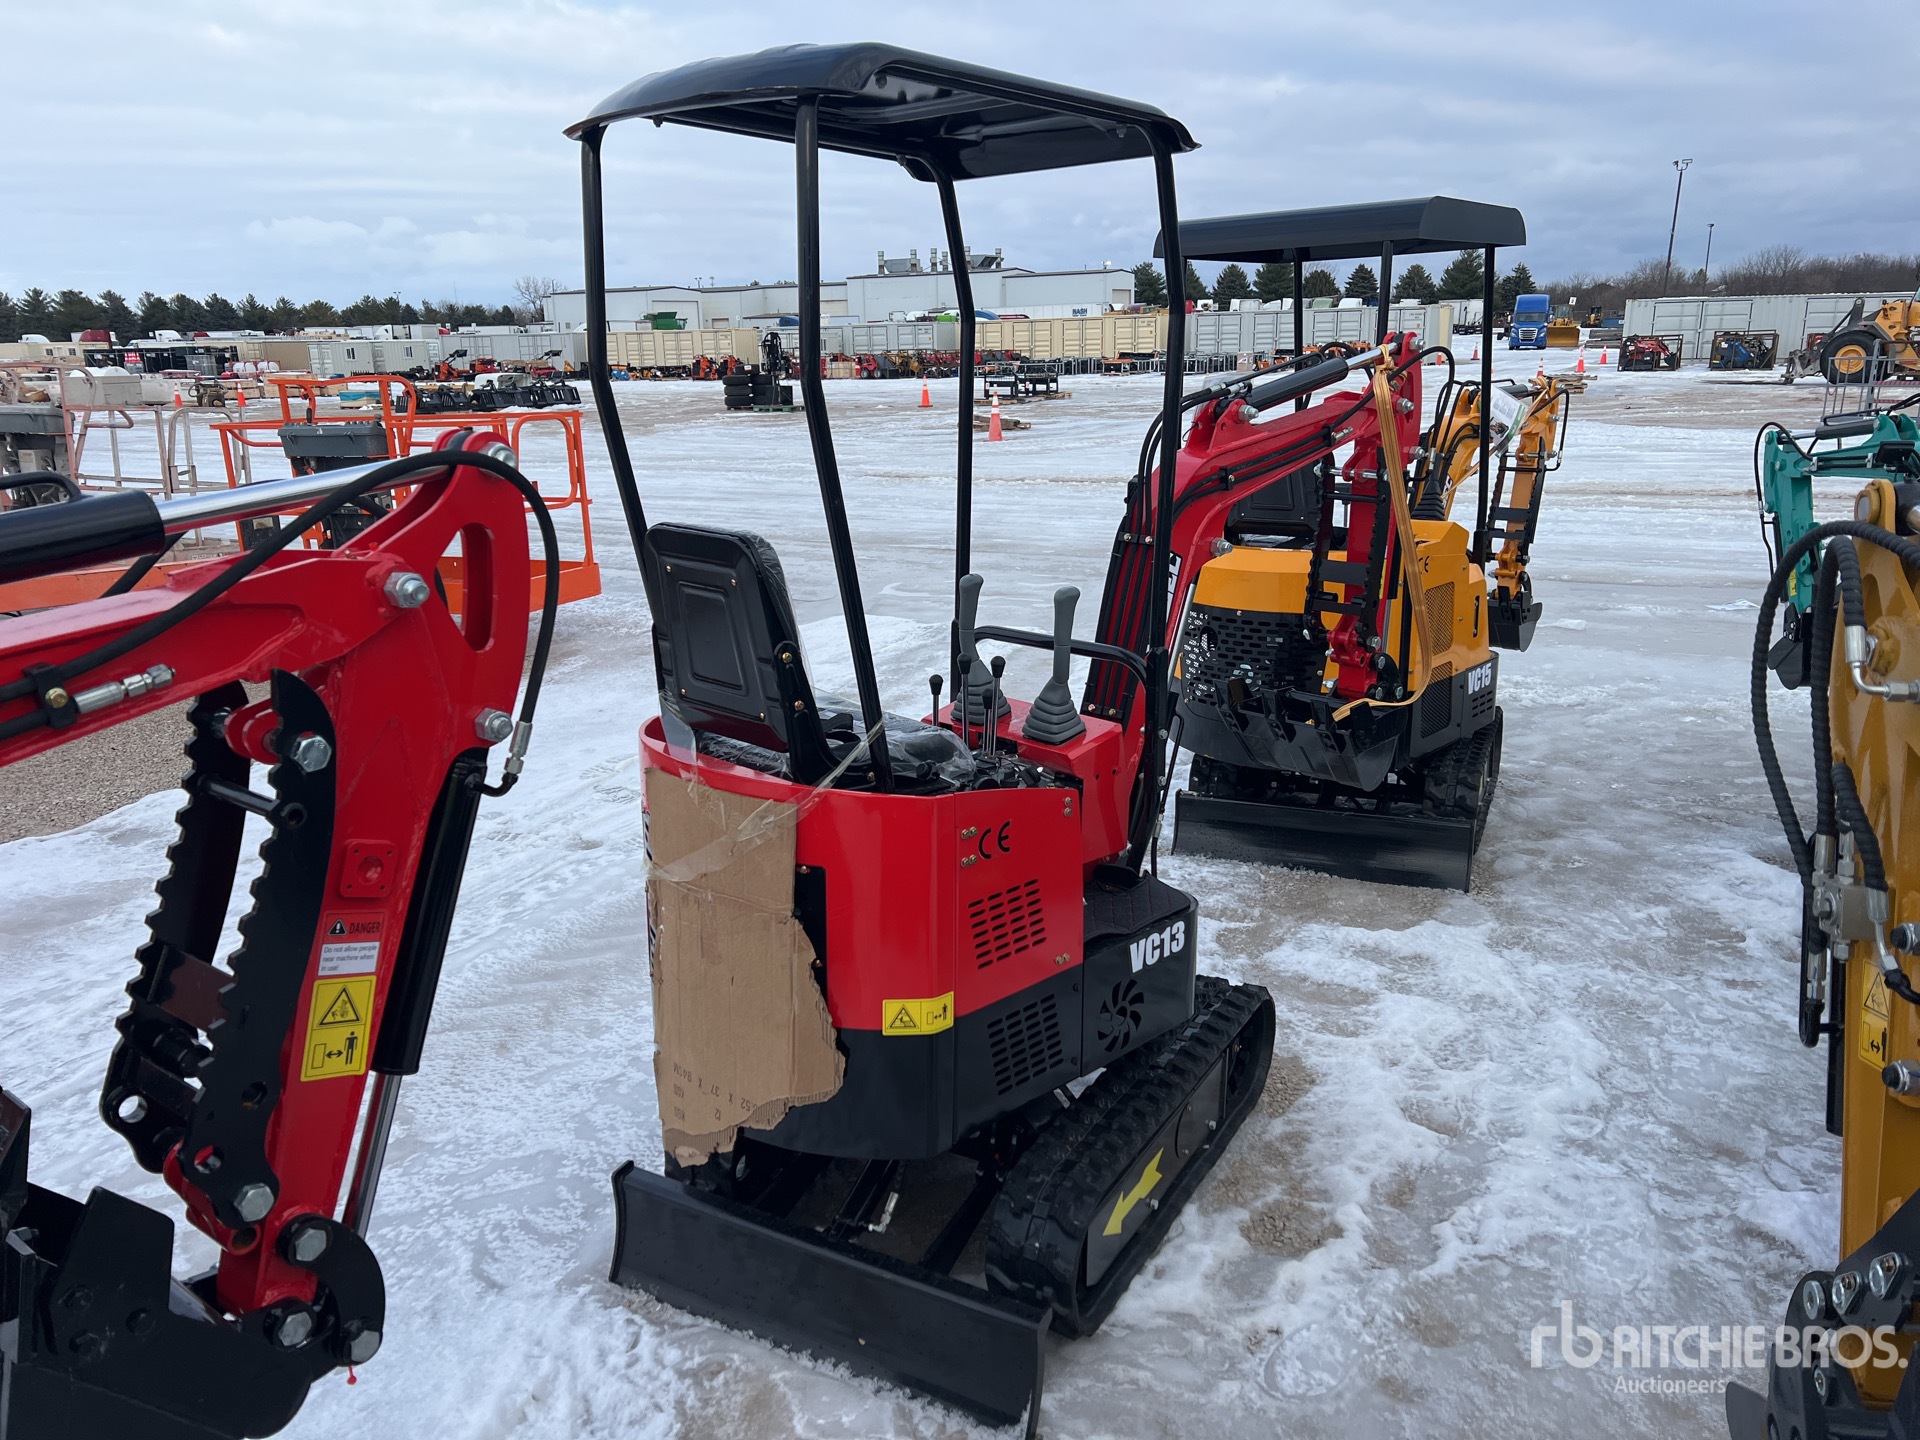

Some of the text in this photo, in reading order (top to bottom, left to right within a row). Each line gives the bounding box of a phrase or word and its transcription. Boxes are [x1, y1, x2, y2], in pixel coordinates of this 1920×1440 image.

[1468, 662, 1492, 695] VC15
[979, 820, 1011, 859] CE
[349, 921, 381, 934] DANGER
[358, 944, 377, 953] people
[1129, 920, 1186, 974] VC13
